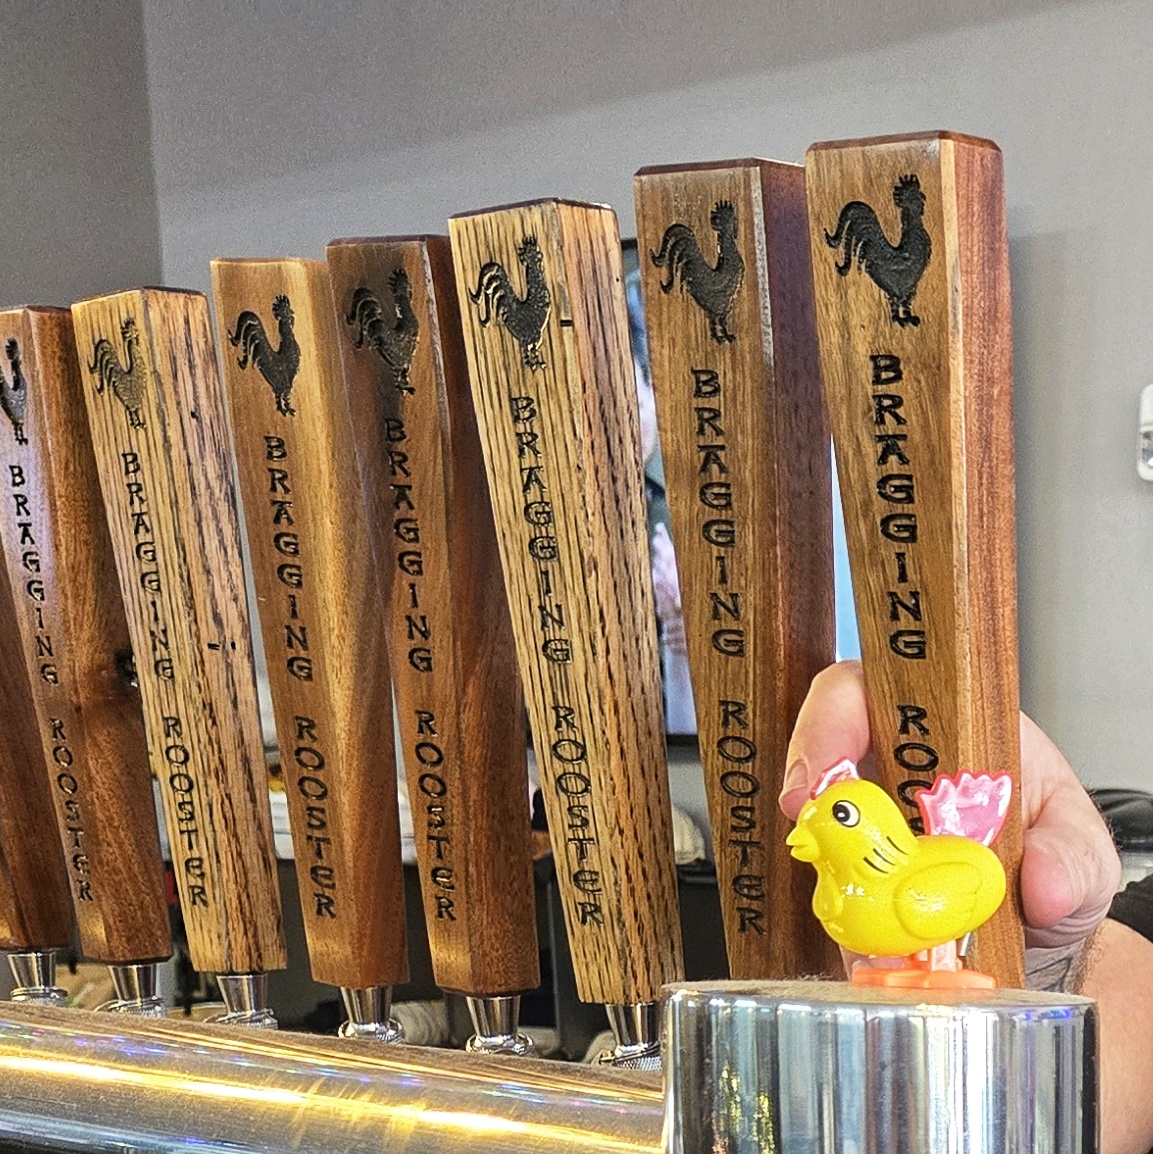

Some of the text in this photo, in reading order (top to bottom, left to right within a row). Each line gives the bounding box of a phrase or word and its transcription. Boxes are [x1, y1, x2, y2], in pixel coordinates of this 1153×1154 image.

[9, 465, 93, 901] BRAGGING ROOSTER
[121, 452, 209, 908] BRAGGING ROOSTER
[264, 435, 337, 919] BRAGGING ROOSTER
[384, 418, 458, 921] BRAGGING ROOSTER
[510, 396, 604, 926] BRAGGING ROOSTER
[691, 368, 767, 936] BRAGGING ROOSTER
[869, 354, 927, 660] BRAGGING
